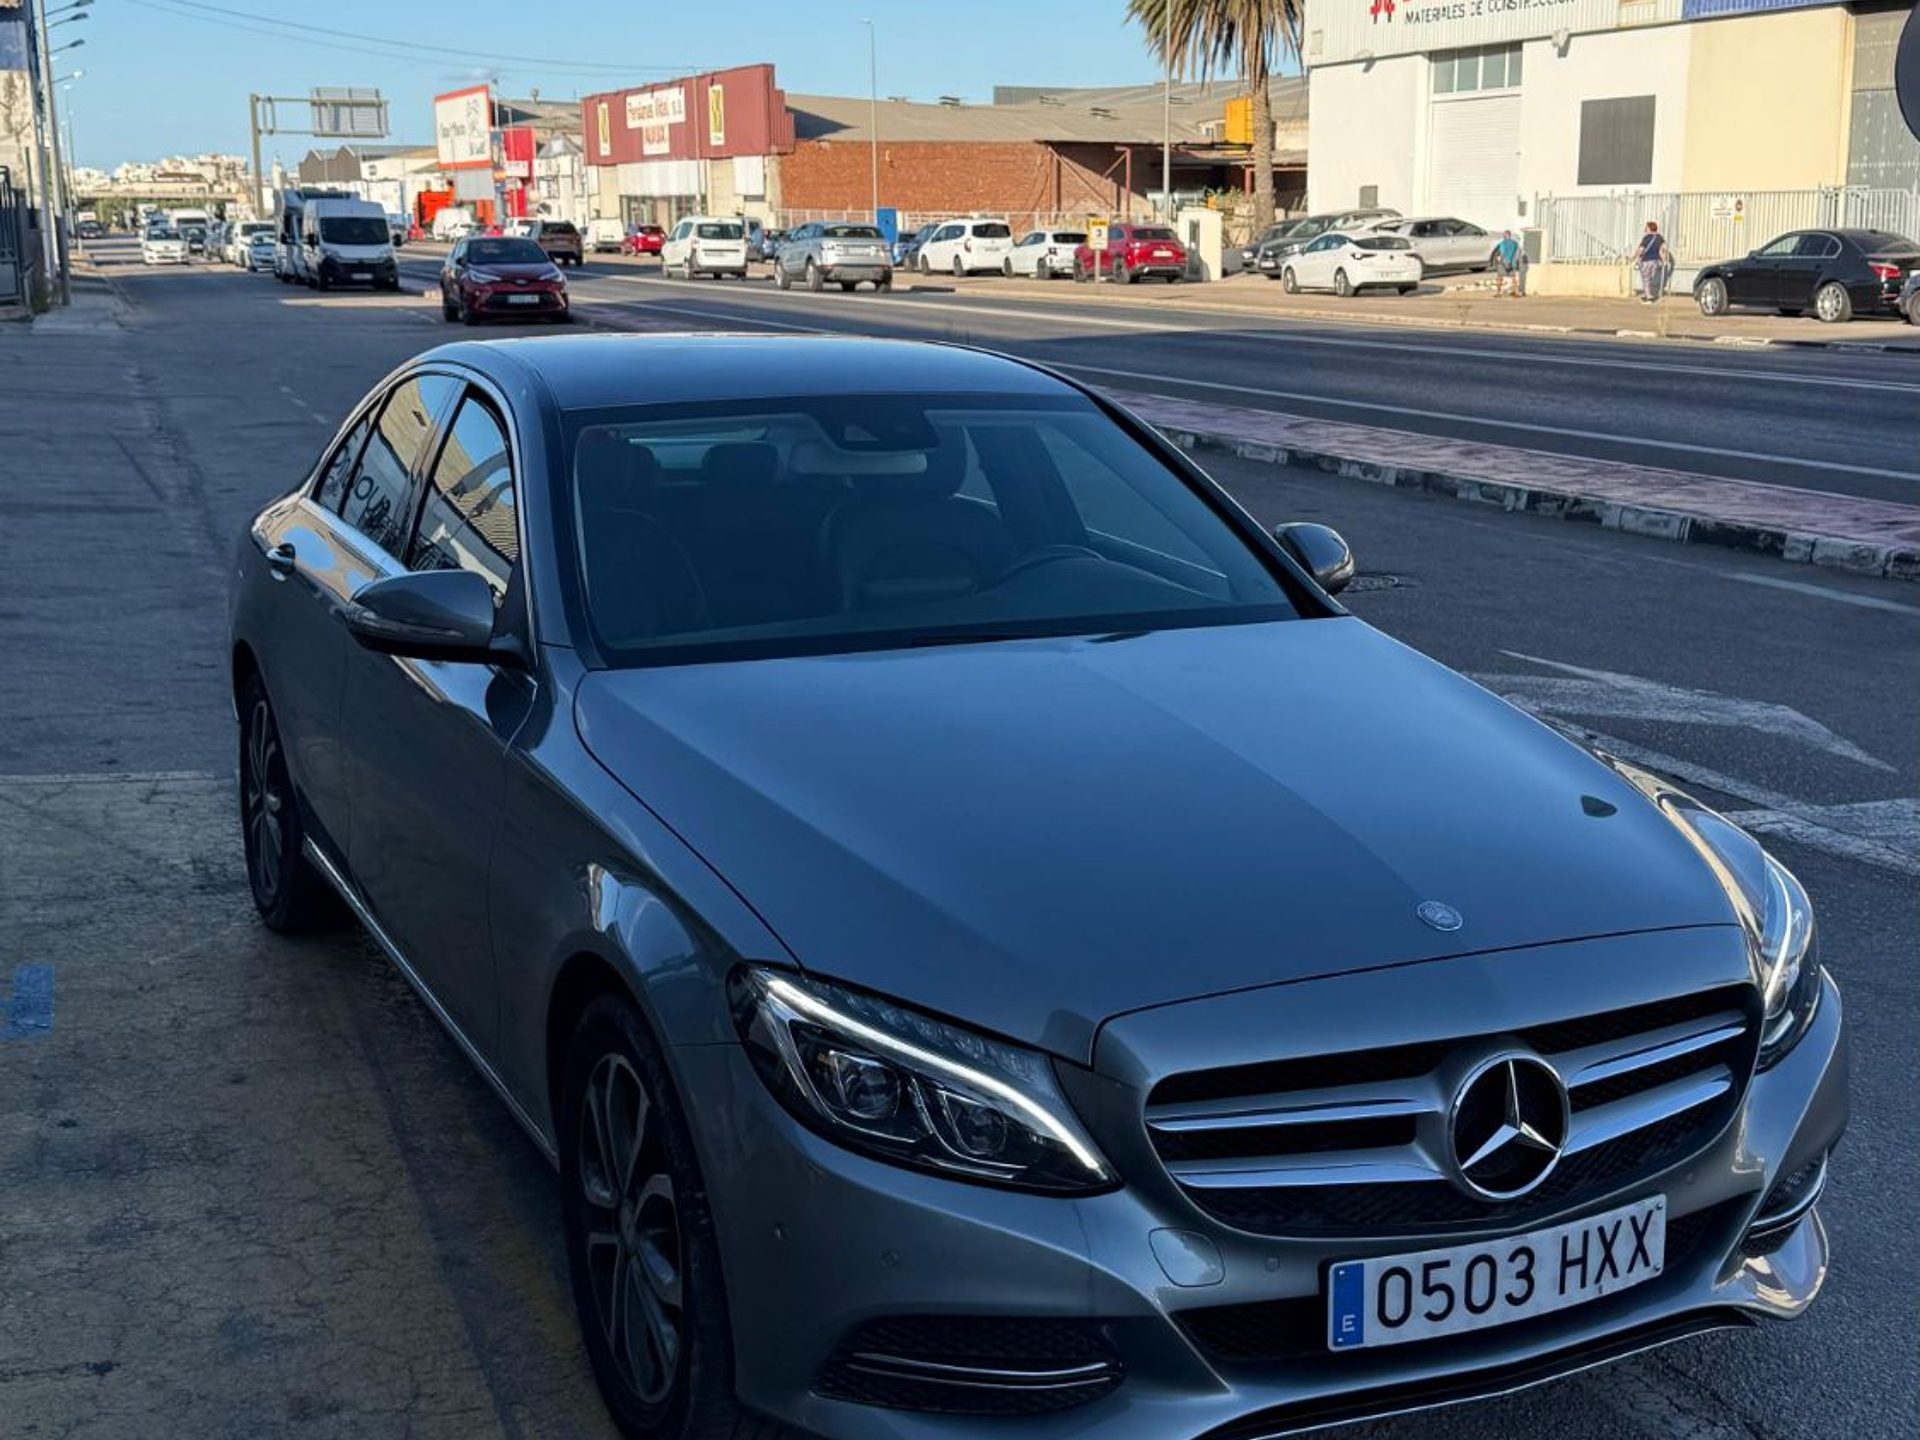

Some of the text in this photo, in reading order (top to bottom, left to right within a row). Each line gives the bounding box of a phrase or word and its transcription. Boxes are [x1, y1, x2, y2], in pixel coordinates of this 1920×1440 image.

[1404, 0, 1575, 25] MATERIALES DE CONSTRU
[1377, 1210, 1654, 1328] 0503 HXX
[1341, 1314, 1356, 1333] E
